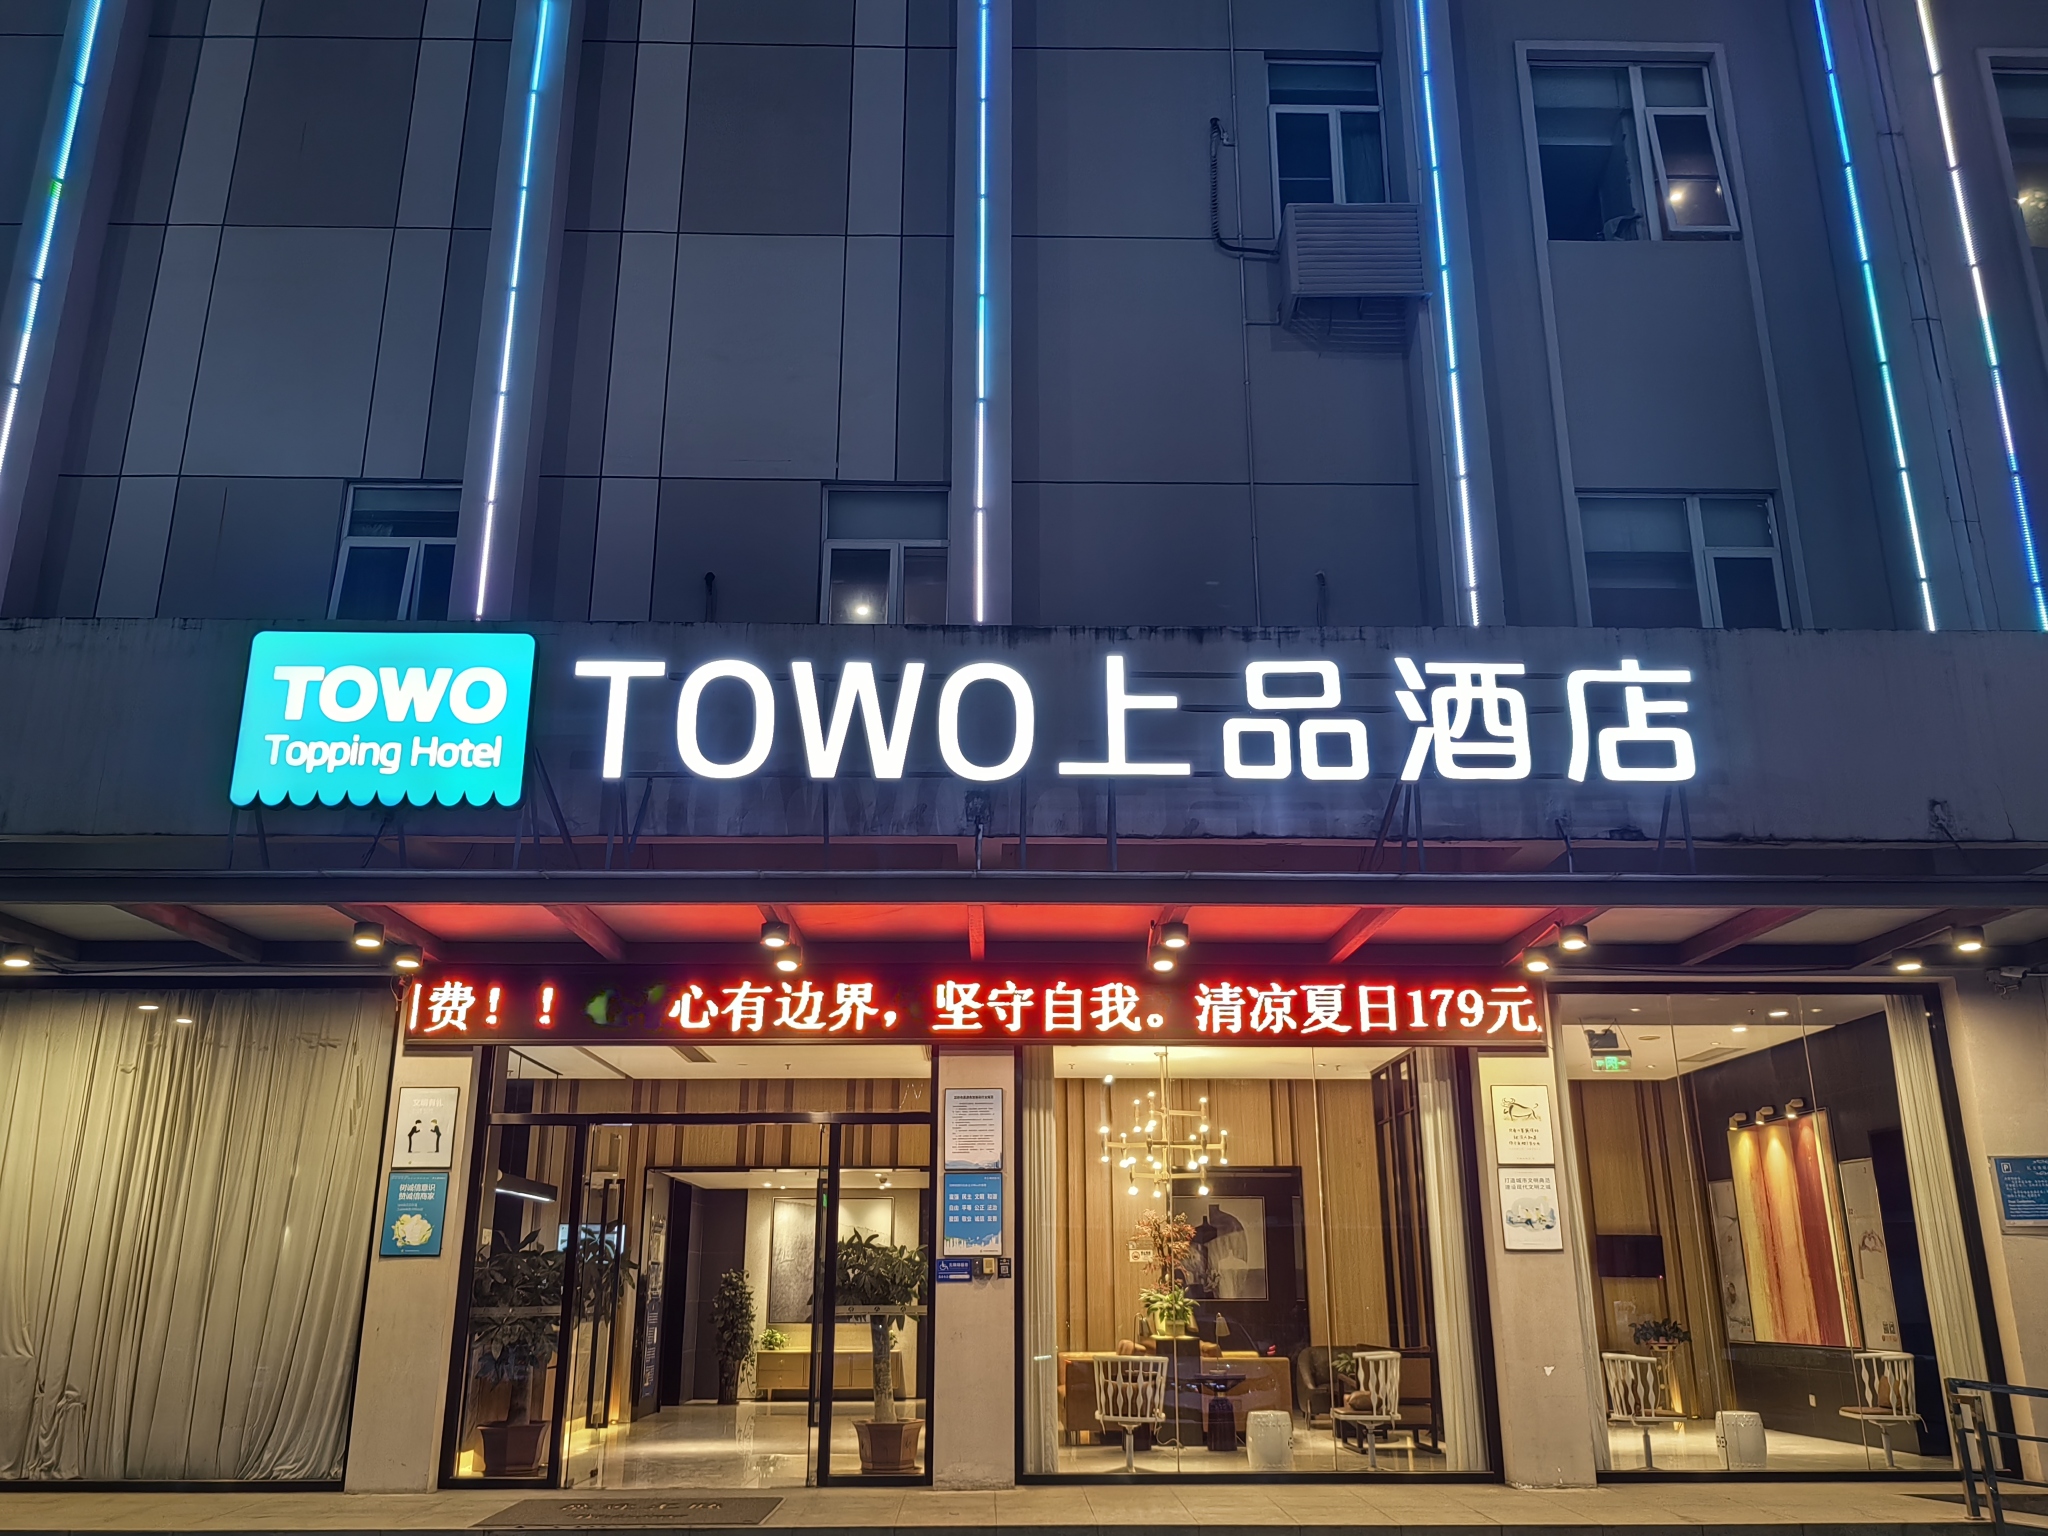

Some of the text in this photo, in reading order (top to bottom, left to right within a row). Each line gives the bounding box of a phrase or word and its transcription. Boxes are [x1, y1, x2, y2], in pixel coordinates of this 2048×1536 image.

[273, 665, 508, 724] TOWO
[575, 655, 1696, 783] TOWO 上品酒店
[264, 734, 503, 775] Topping Hotel
